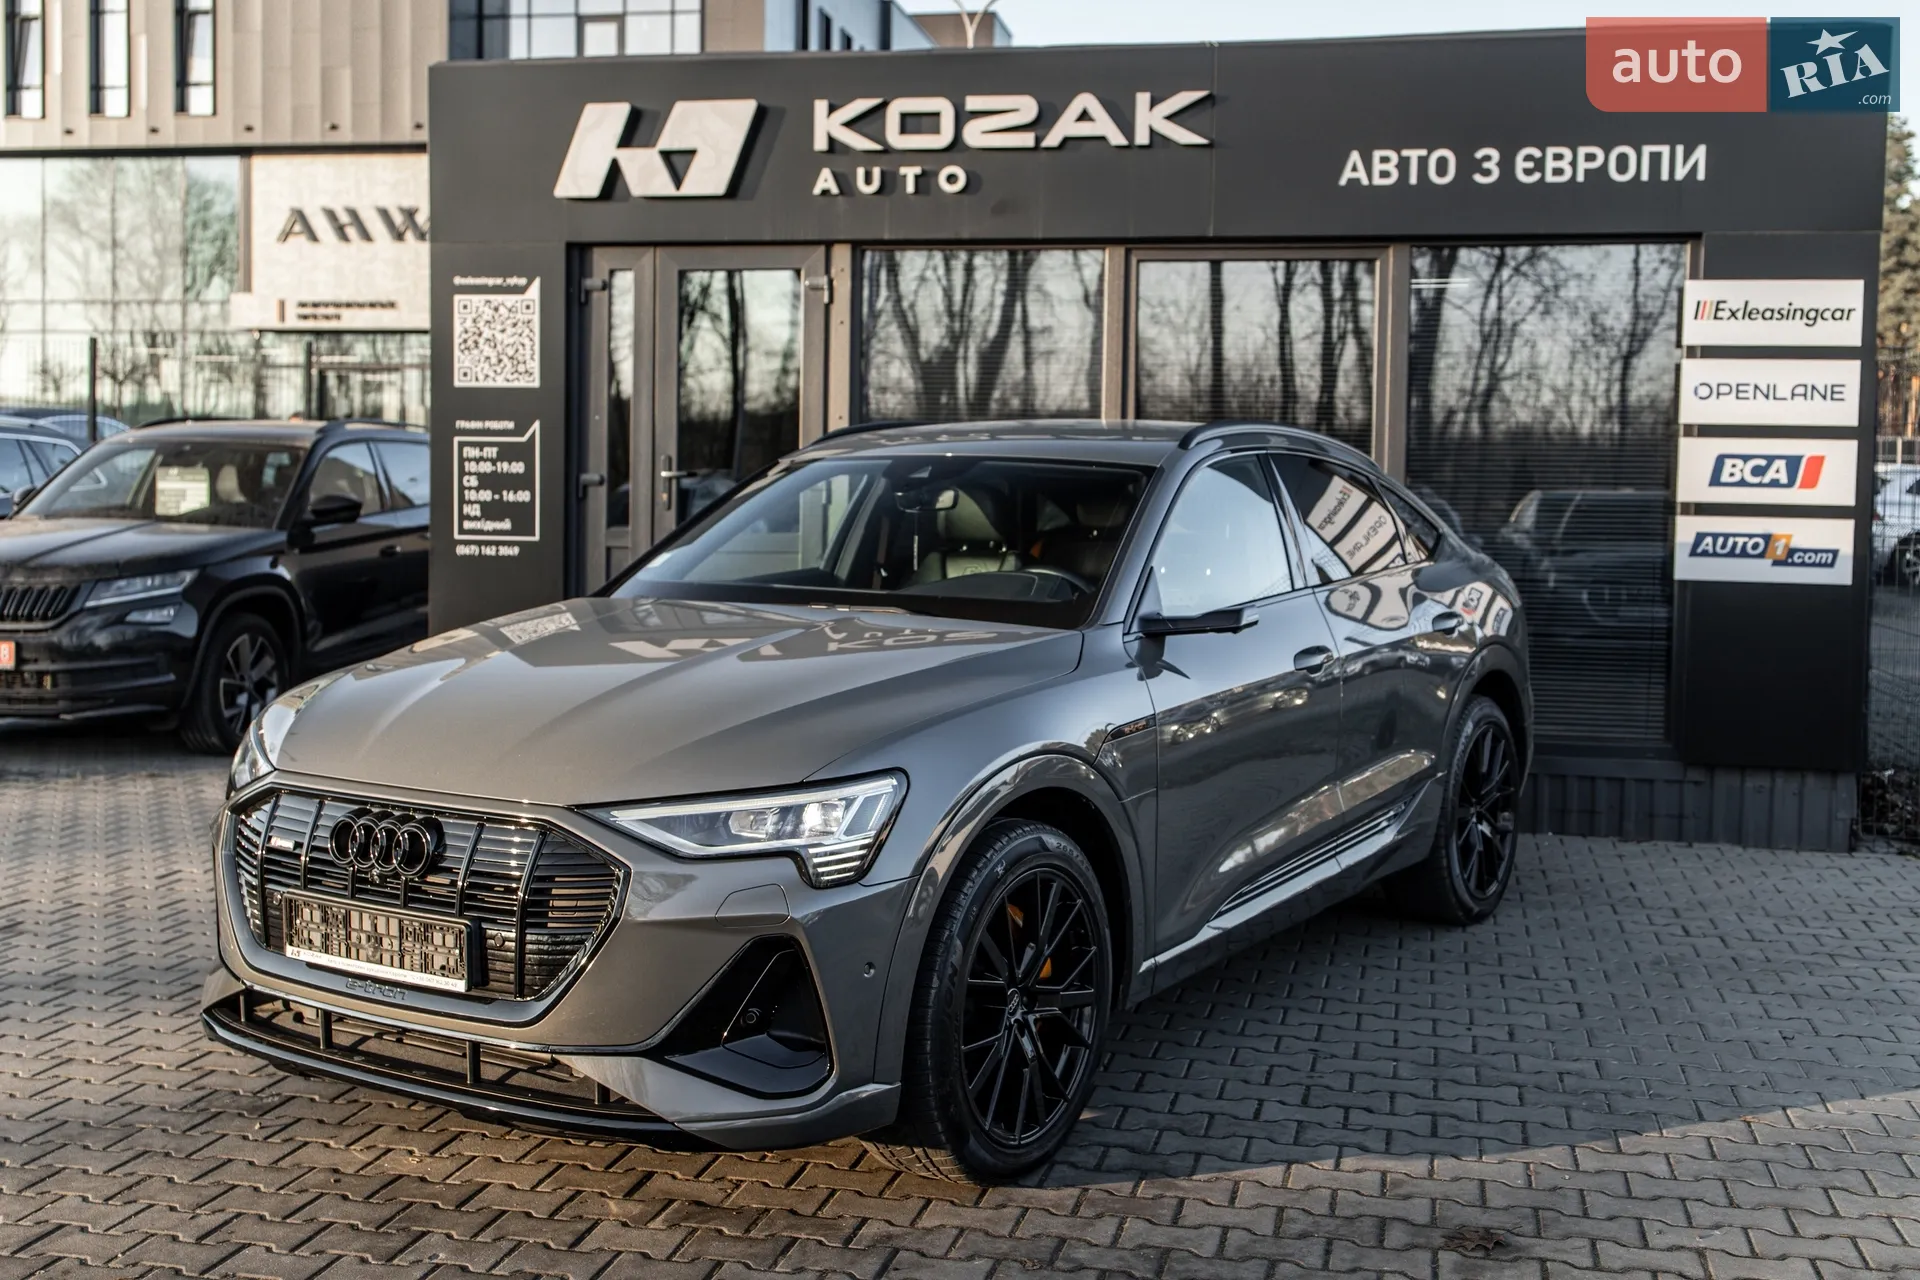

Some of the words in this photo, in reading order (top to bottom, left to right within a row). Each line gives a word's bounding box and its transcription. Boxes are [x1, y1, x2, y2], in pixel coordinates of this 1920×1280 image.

[813, 90, 1212, 153] KOZAK
[1338, 148, 1457, 187] АВТО
[1514, 144, 1708, 183] ЄВРОПИ
[811, 165, 968, 196] AUTO
[1713, 300, 1857, 327] Exleasingcar
[1693, 382, 1847, 402] OPENLANE
[1719, 457, 1789, 485] BCA
[345, 978, 408, 1000] e-tron
